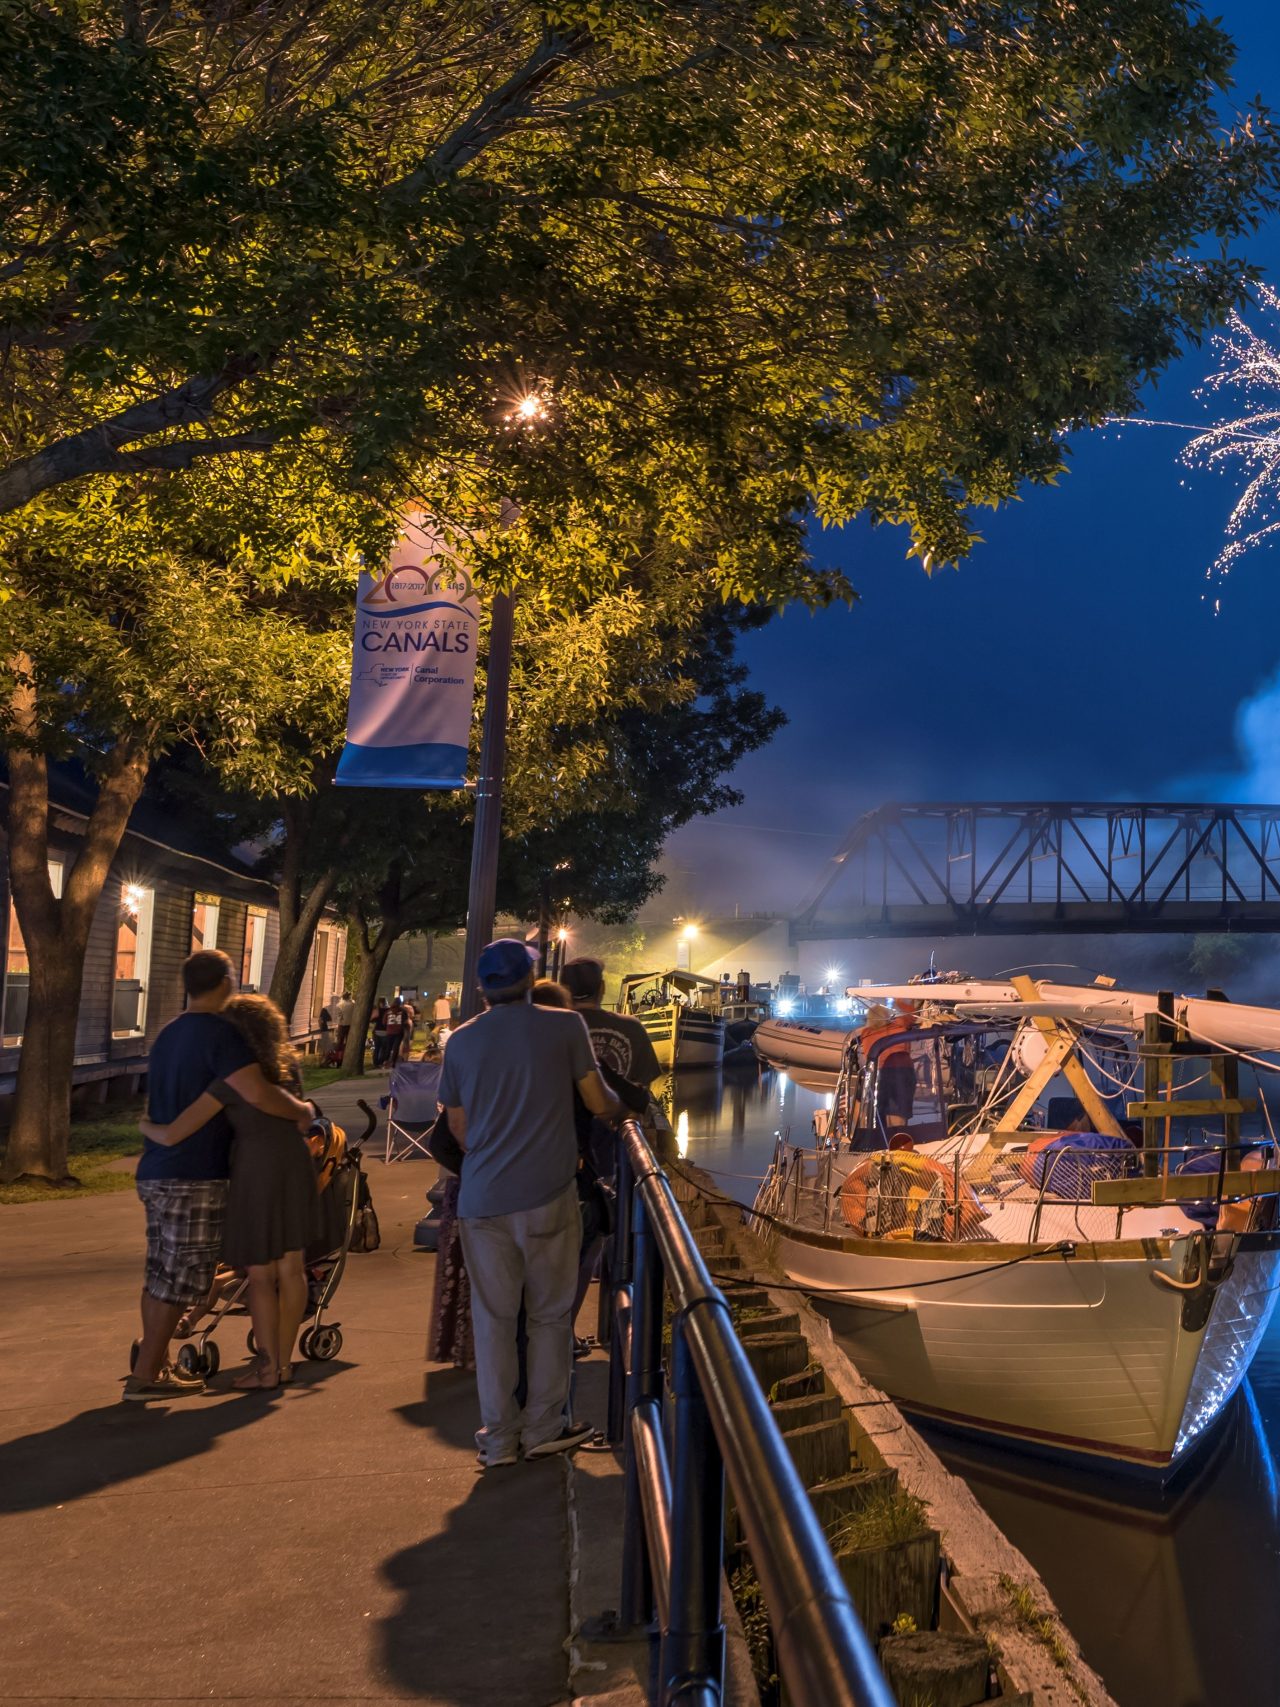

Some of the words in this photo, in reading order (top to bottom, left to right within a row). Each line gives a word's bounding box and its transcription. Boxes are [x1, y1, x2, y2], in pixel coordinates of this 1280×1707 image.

[434, 582, 465, 590] YARS
[362, 620, 390, 630] NEW
[397, 620, 429, 630] YORK
[434, 620, 470, 631] STATE
[362, 632, 469, 654] CANALS
[415, 666, 439, 674] Canal
[414, 675, 465, 685] Corporation
